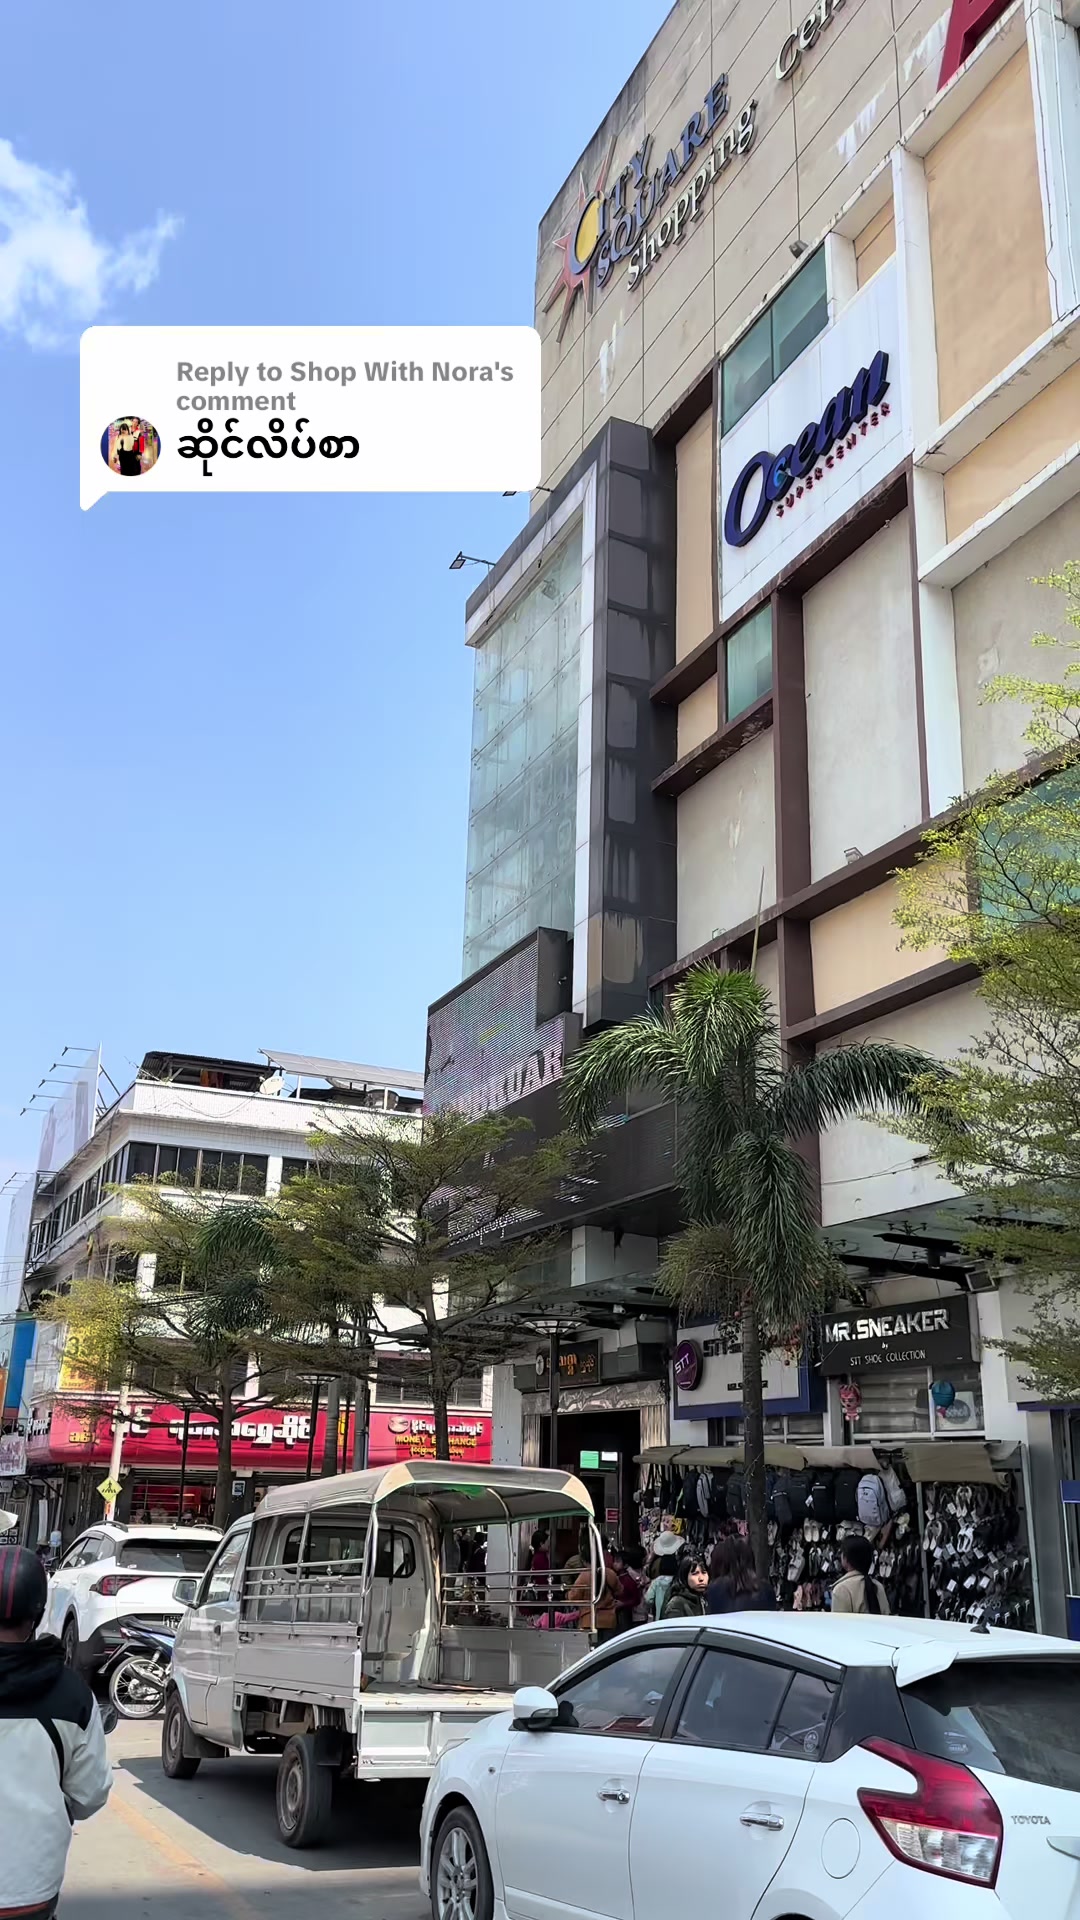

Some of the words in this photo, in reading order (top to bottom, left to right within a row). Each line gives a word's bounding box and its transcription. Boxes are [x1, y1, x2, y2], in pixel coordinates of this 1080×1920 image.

[568, 134, 654, 275] CITY
[597, 73, 730, 288] SQUARE
[627, 99, 758, 292] Shopping
[724, 350, 890, 547] Ocean
[775, 402, 891, 518] SUPERCENTER
[825, 1308, 950, 1343] MR.SNEAKER
[865, 1354, 882, 1365] SHOE
[886, 1349, 926, 1362] COLLECTION
[674, 1353, 691, 1374] STT
[396, 1435, 426, 1446] MONEY
[432, 1436, 477, 1447] EHANGE
[1011, 1815, 1051, 1825] TOYOTA
